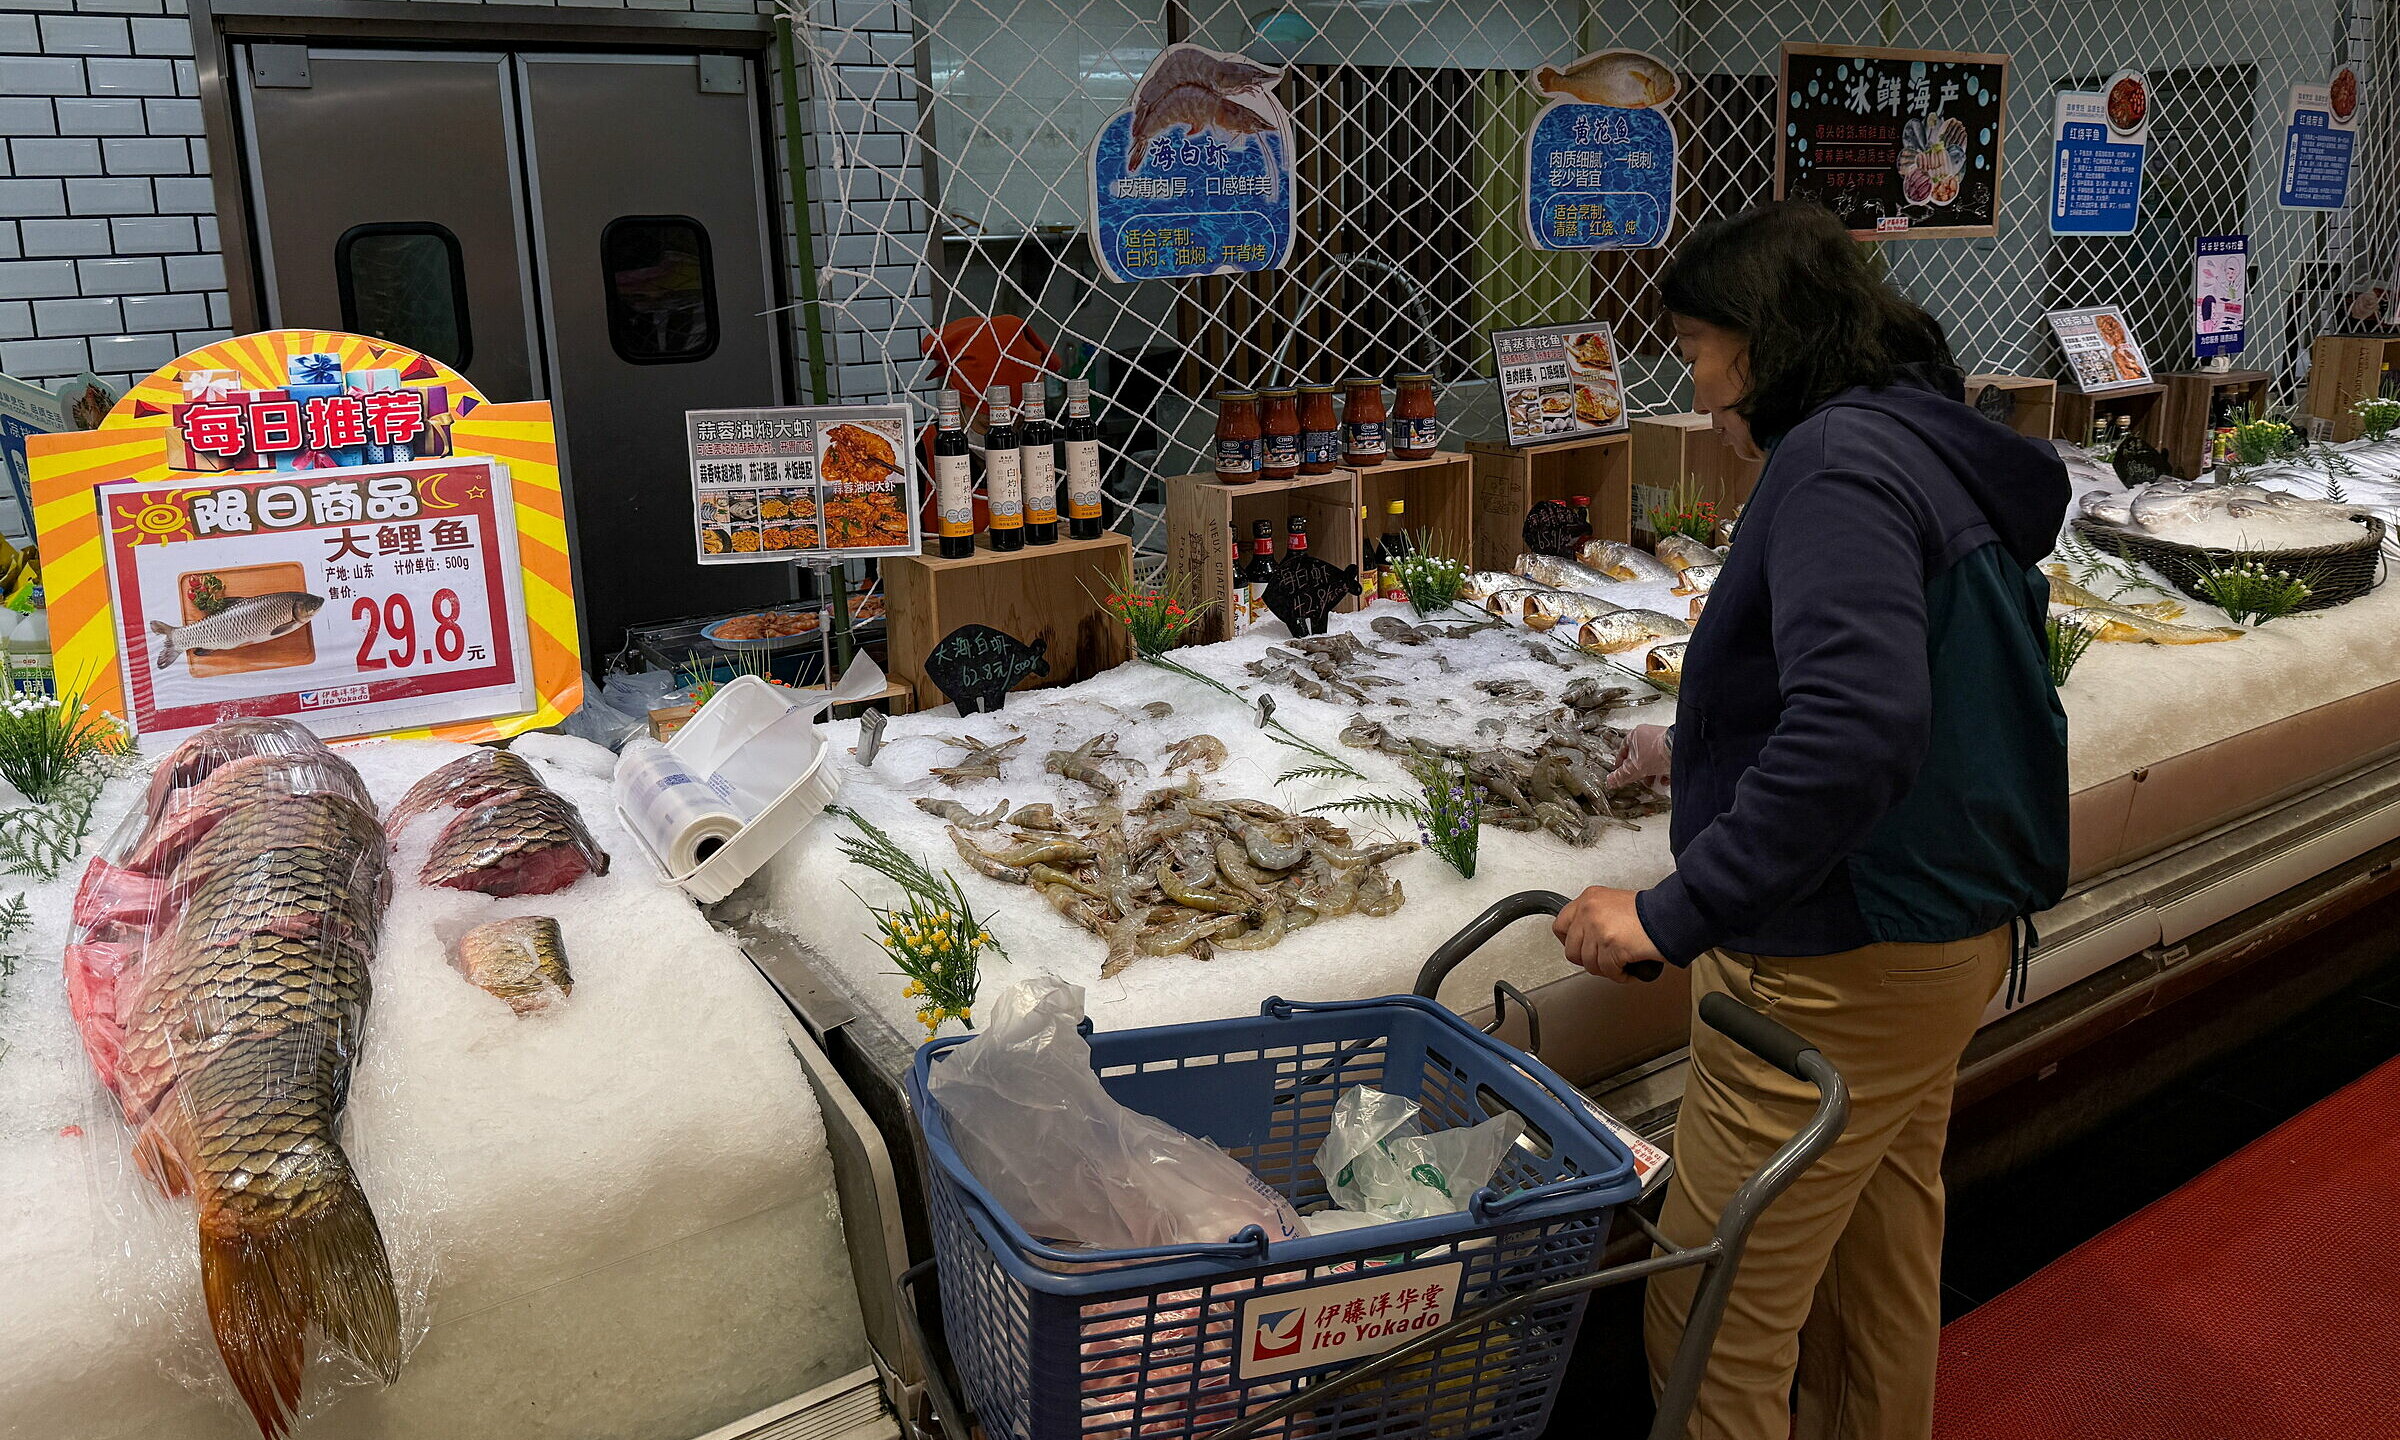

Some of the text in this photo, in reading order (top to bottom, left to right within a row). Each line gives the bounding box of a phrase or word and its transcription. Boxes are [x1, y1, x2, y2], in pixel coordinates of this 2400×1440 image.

[1844, 75, 1960, 117] 冰鲜海产
[1572, 114, 1631, 144] 黄花鱼
[1150, 136, 1230, 171] 海白虾
[1117, 175, 1272, 198] 皮薄肉厚，口感鲜美
[1549, 170, 1602, 187] 老少皆宜
[1126, 244, 1267, 267] 白灼、油焖、开背烤
[1499, 334, 1562, 353] 清蒸黄花鱼
[184, 392, 424, 456] 每日推荐
[697, 419, 812, 441] 蒜蓉油焖大虾
[832, 480, 897, 495] 蒜蓉油焖大虾
[1006, 468, 1017, 498] 白灼汁
[1044, 463, 1053, 492] 白灼汁
[1089, 458, 1098, 487] 白灼汁
[194, 477, 420, 535] 限日商品
[324, 519, 475, 563] 大鲤鱼
[1208, 518, 1222, 554] VIEUX
[328, 585, 357, 600] 售价：
[351, 587, 486, 672] 29.8 元
[322, 693, 369, 705] Ito Yokado
[1314, 1284, 1444, 1330] 伊藤洋华堂
[1311, 1312, 1441, 1350] Ito Yokado
